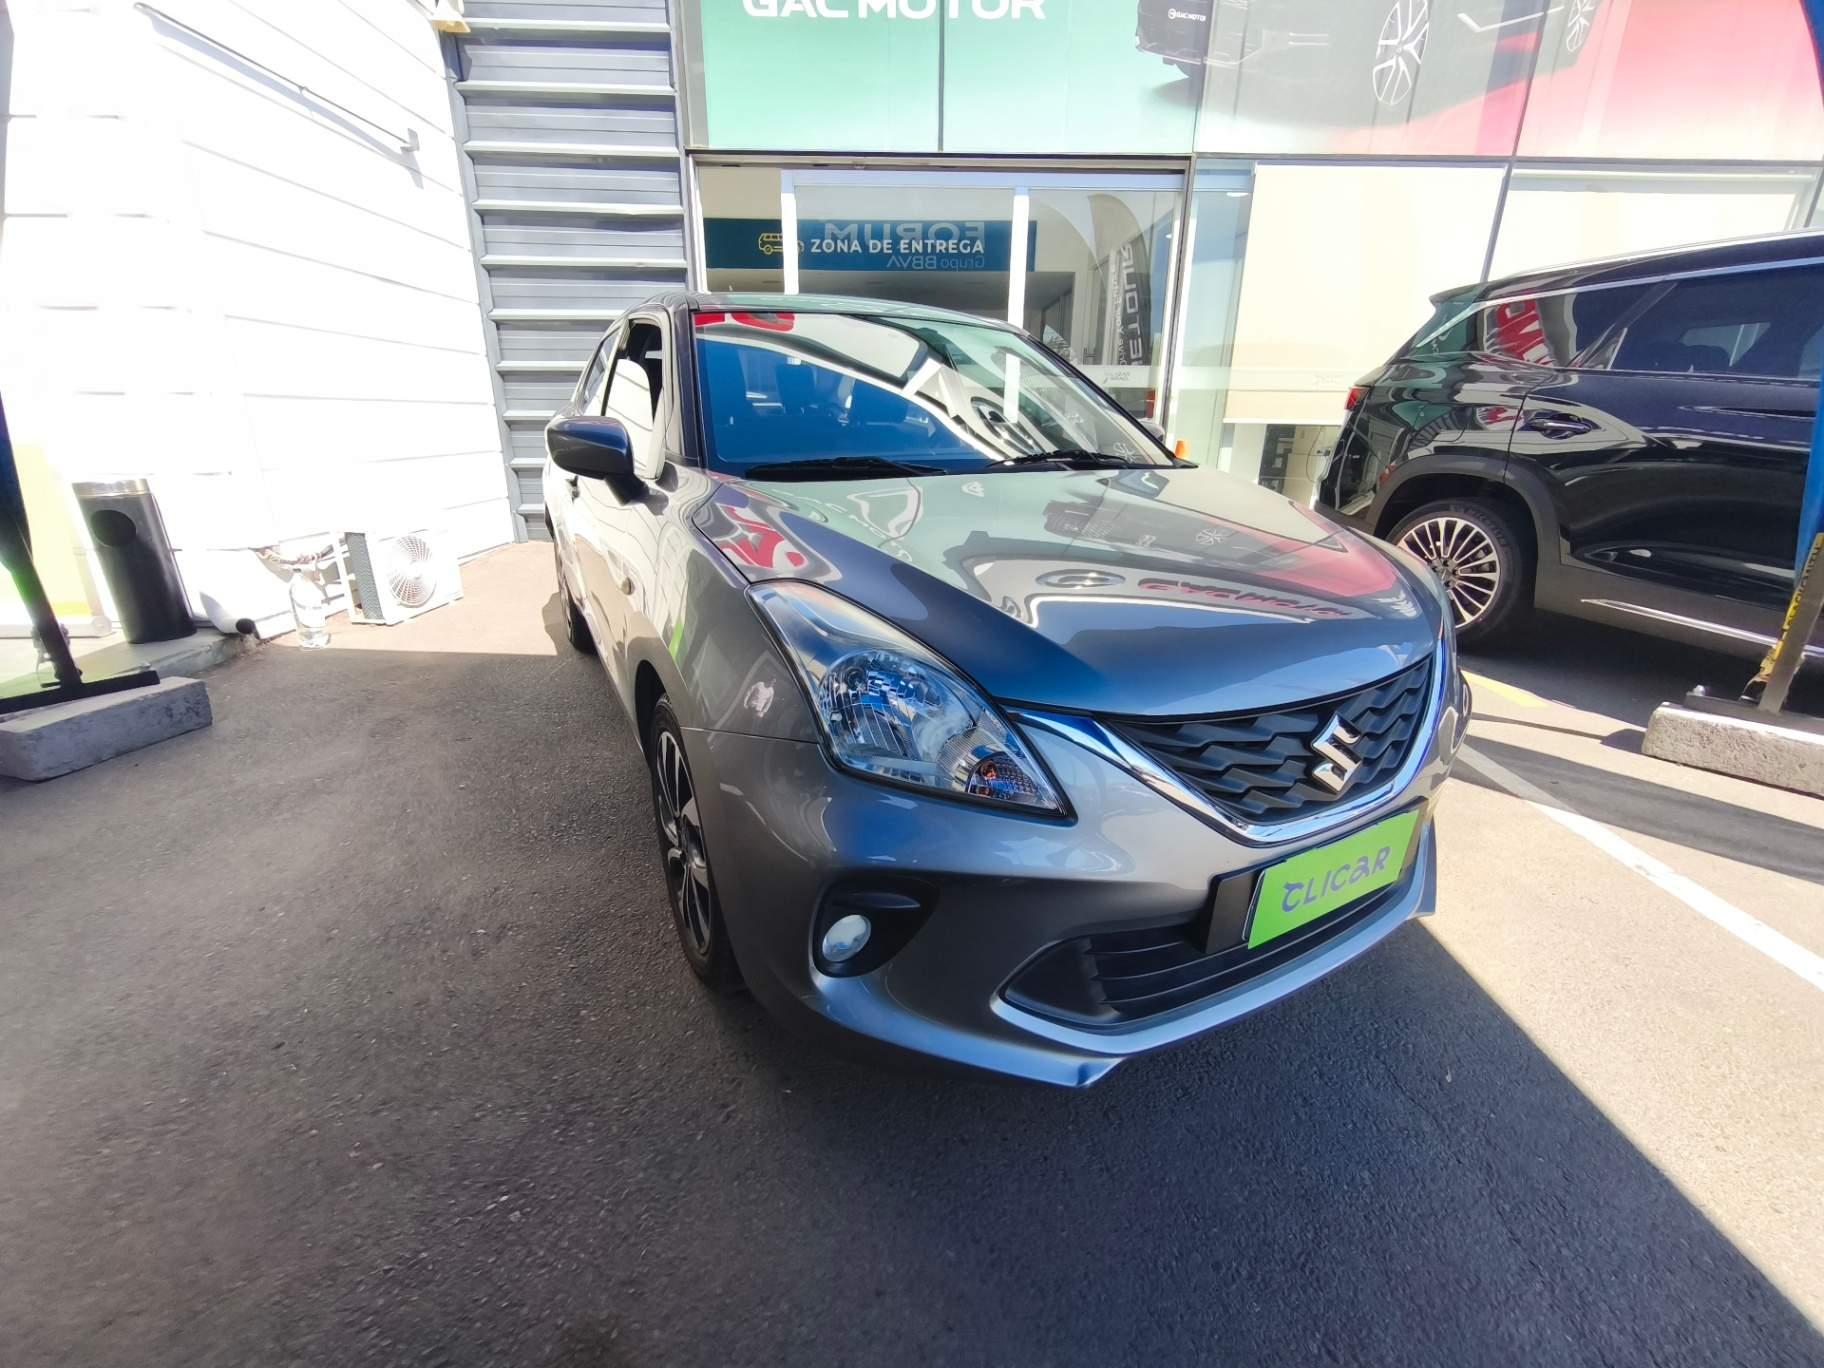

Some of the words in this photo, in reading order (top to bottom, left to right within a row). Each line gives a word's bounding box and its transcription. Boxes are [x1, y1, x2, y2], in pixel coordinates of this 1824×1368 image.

[810, 239, 862, 253] ZONA
[869, 240, 893, 253] DE
[900, 239, 985, 254] ENTREGA
